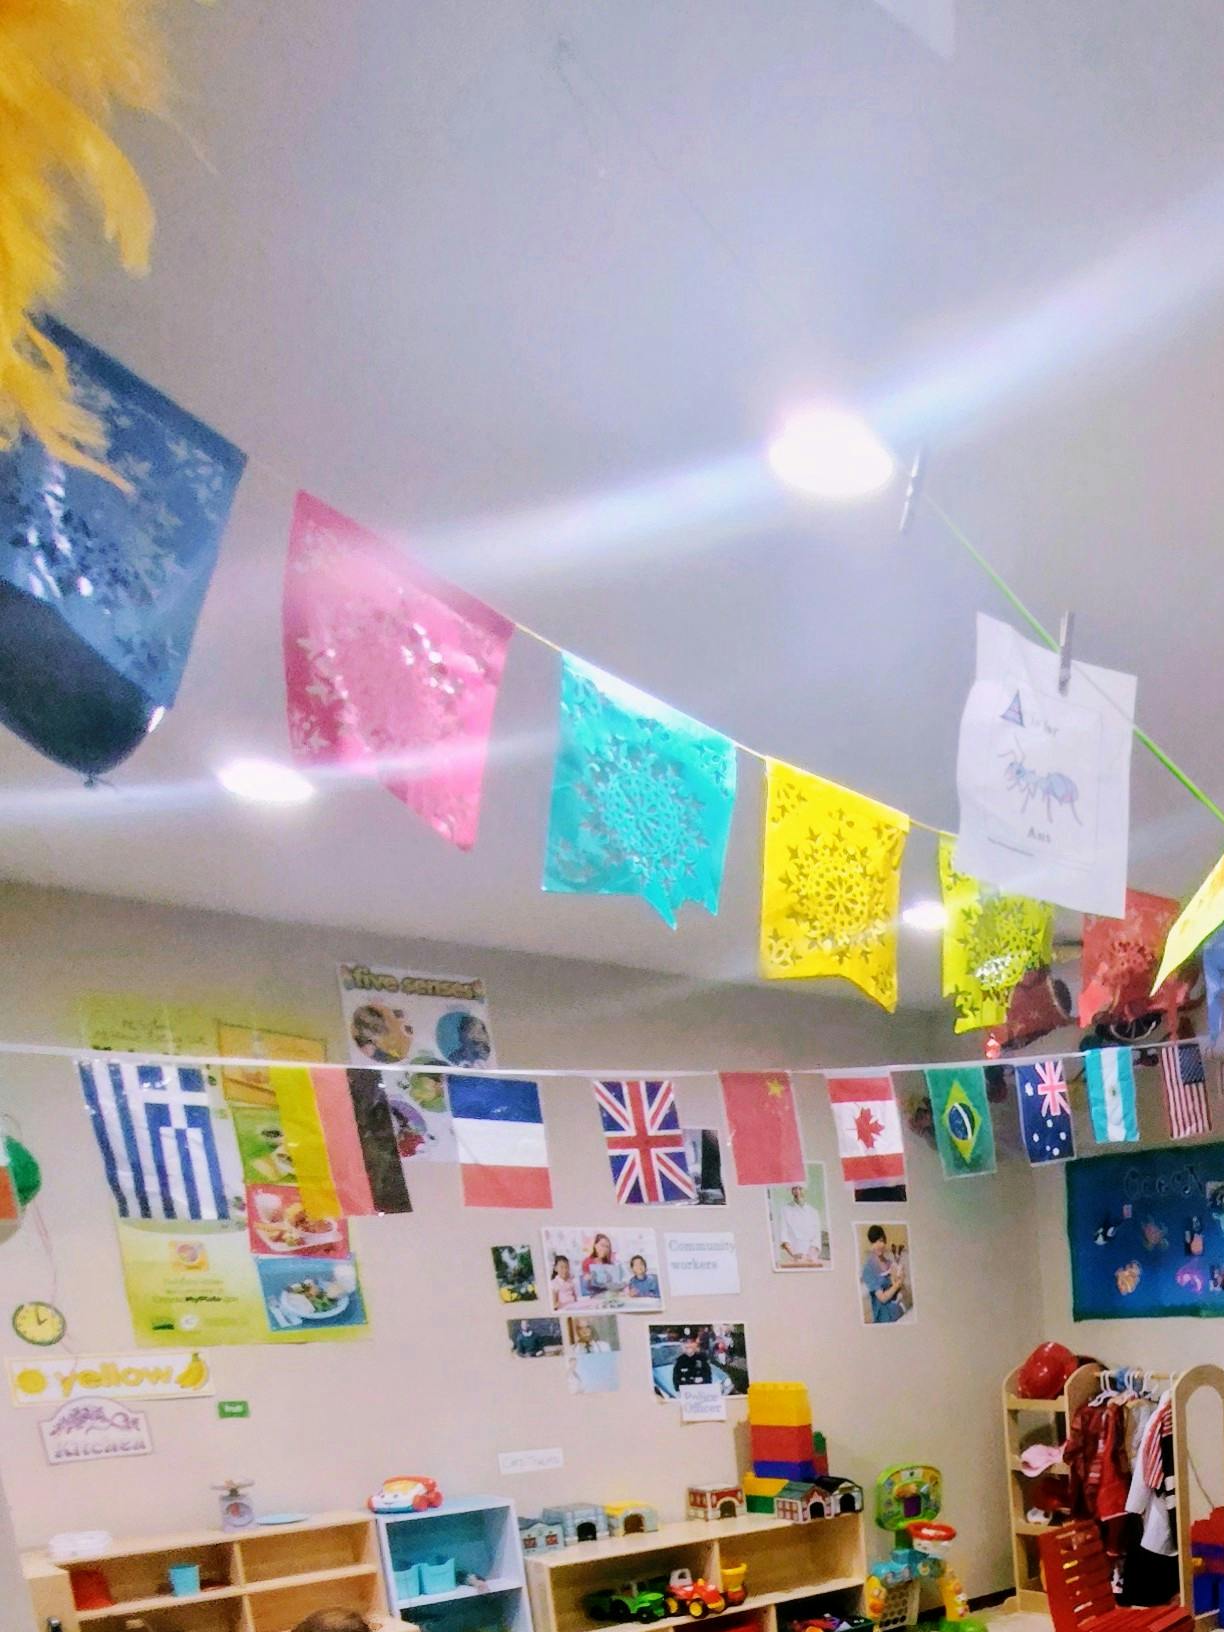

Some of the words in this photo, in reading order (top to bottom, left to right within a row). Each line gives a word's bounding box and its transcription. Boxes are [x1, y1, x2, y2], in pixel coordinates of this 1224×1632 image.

[999, 688, 1026, 728] A
[351, 965, 400, 994] five
[401, 976, 475, 1001] senses
[668, 1239, 736, 1255] Community
[670, 1258, 719, 1270] workers
[54, 1361, 174, 1398] yellow
